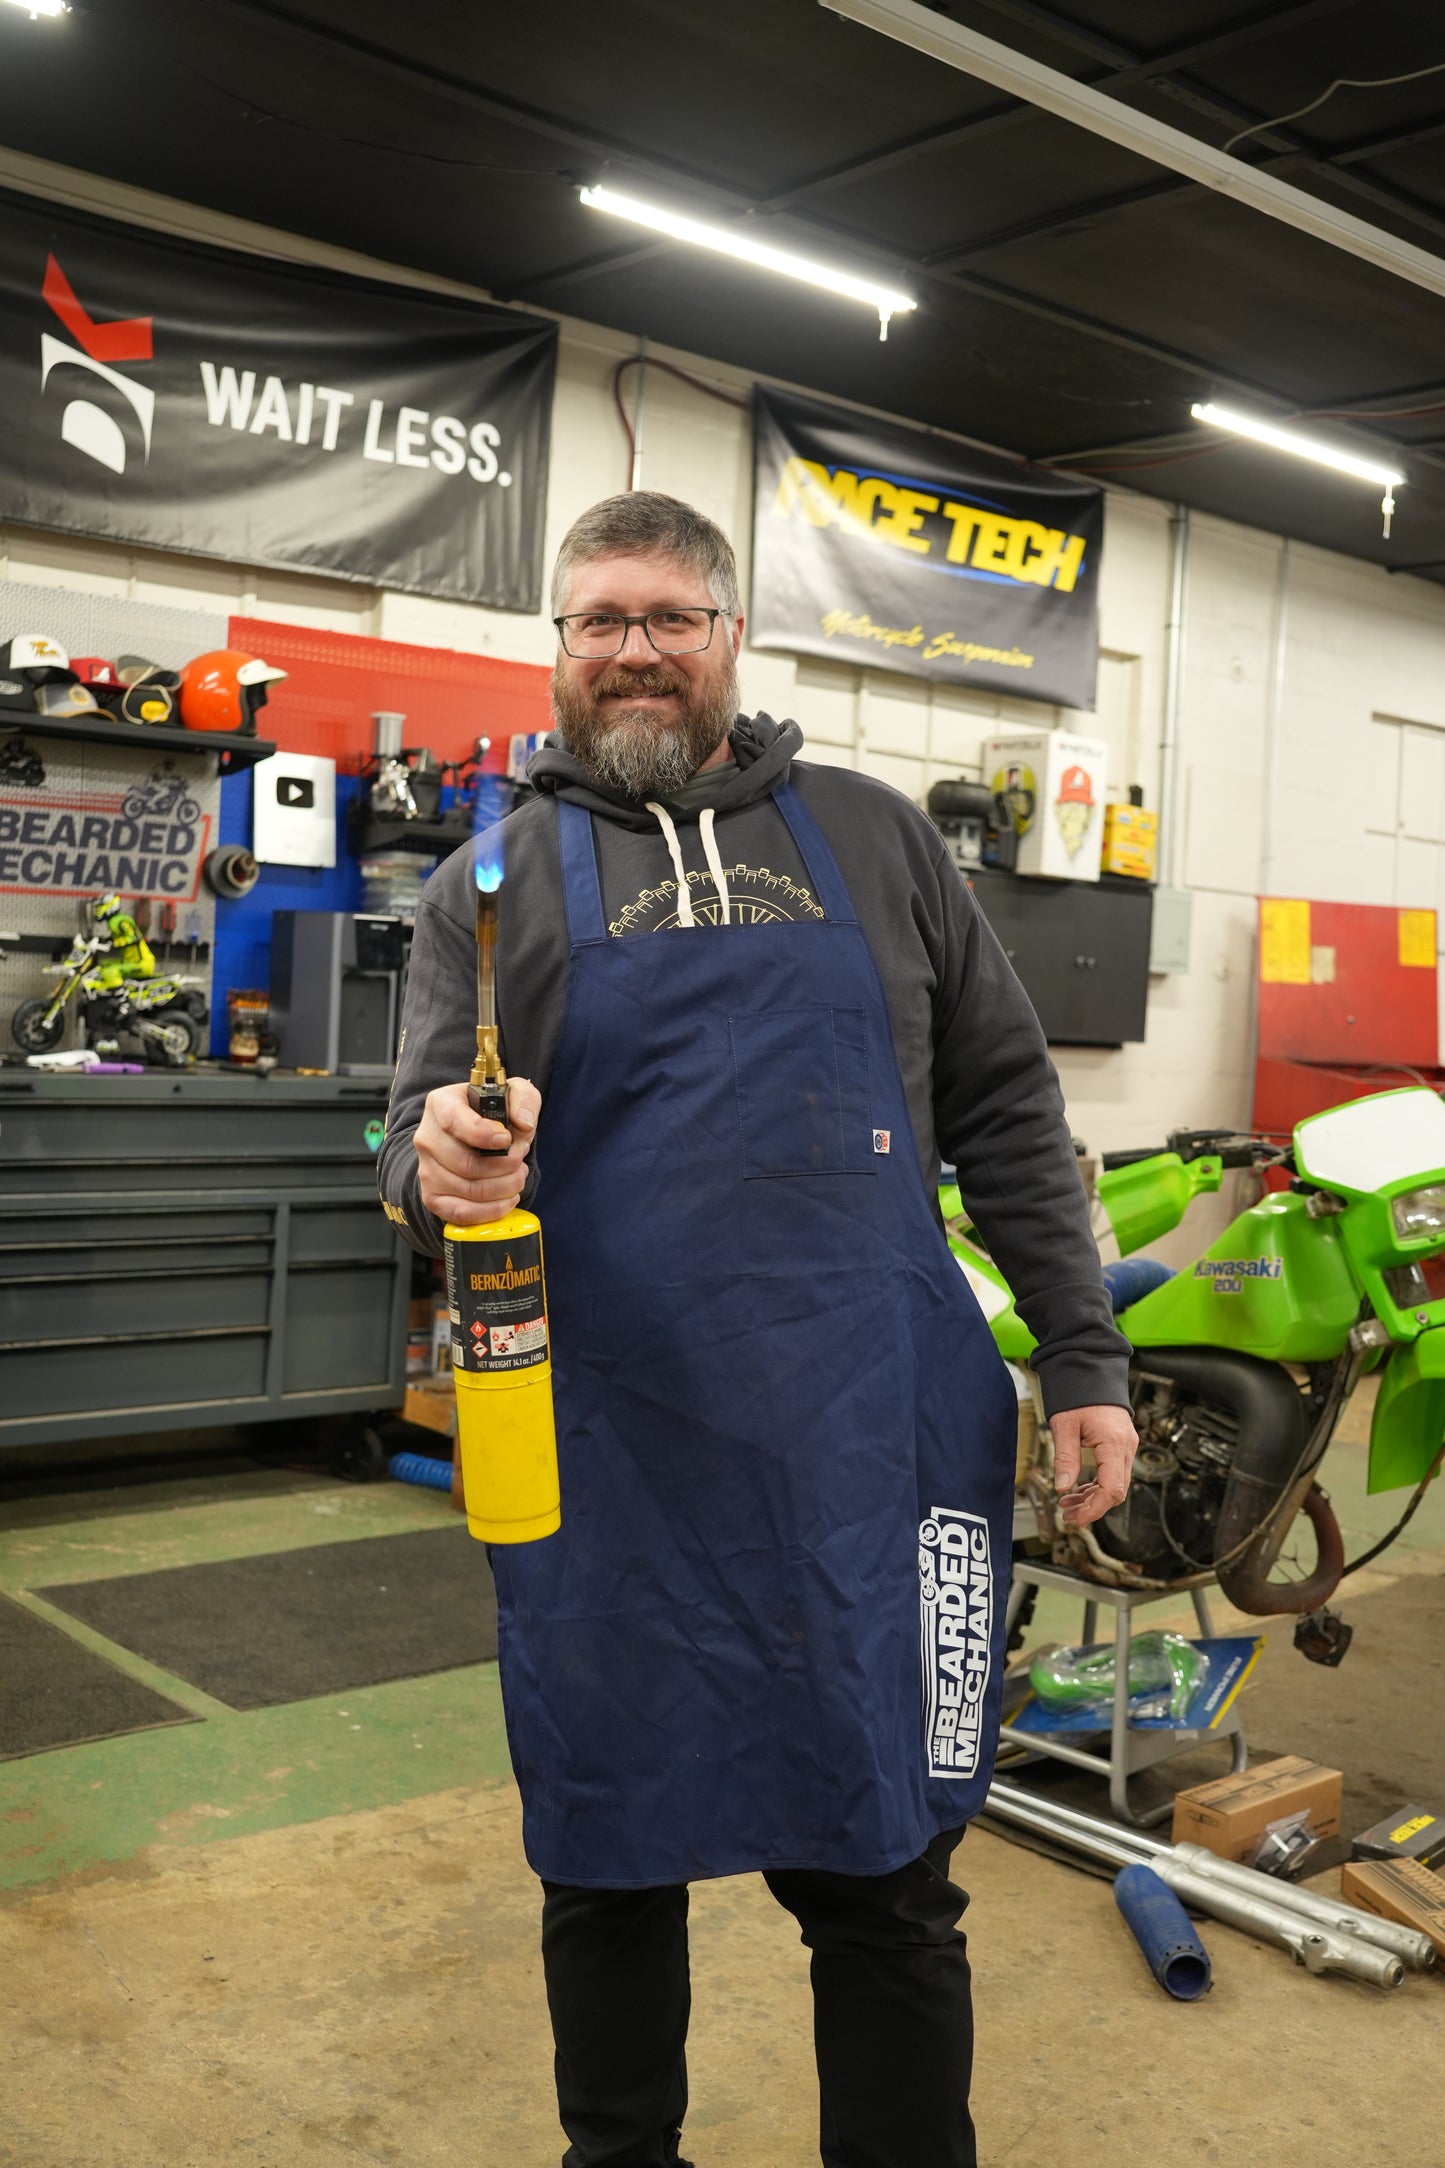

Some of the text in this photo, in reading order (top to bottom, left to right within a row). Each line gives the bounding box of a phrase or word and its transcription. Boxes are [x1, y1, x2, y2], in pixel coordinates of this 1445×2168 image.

[200, 361, 512, 487] WAIT LESS.
[771, 456, 1086, 592] RACE TECH
[0, 809, 196, 856] BEARDED
[470, 1265, 540, 1290] BERNZOMATIC
[1194, 1257, 1282, 1279] Kawasaki
[525, 1316, 544, 1331] DANGER
[477, 1360, 488, 1369] NET
[488, 1359, 512, 1369] WEIGHT
[935, 1522, 969, 1738] BEARDED
[954, 1527, 989, 1768] MECHANIC
